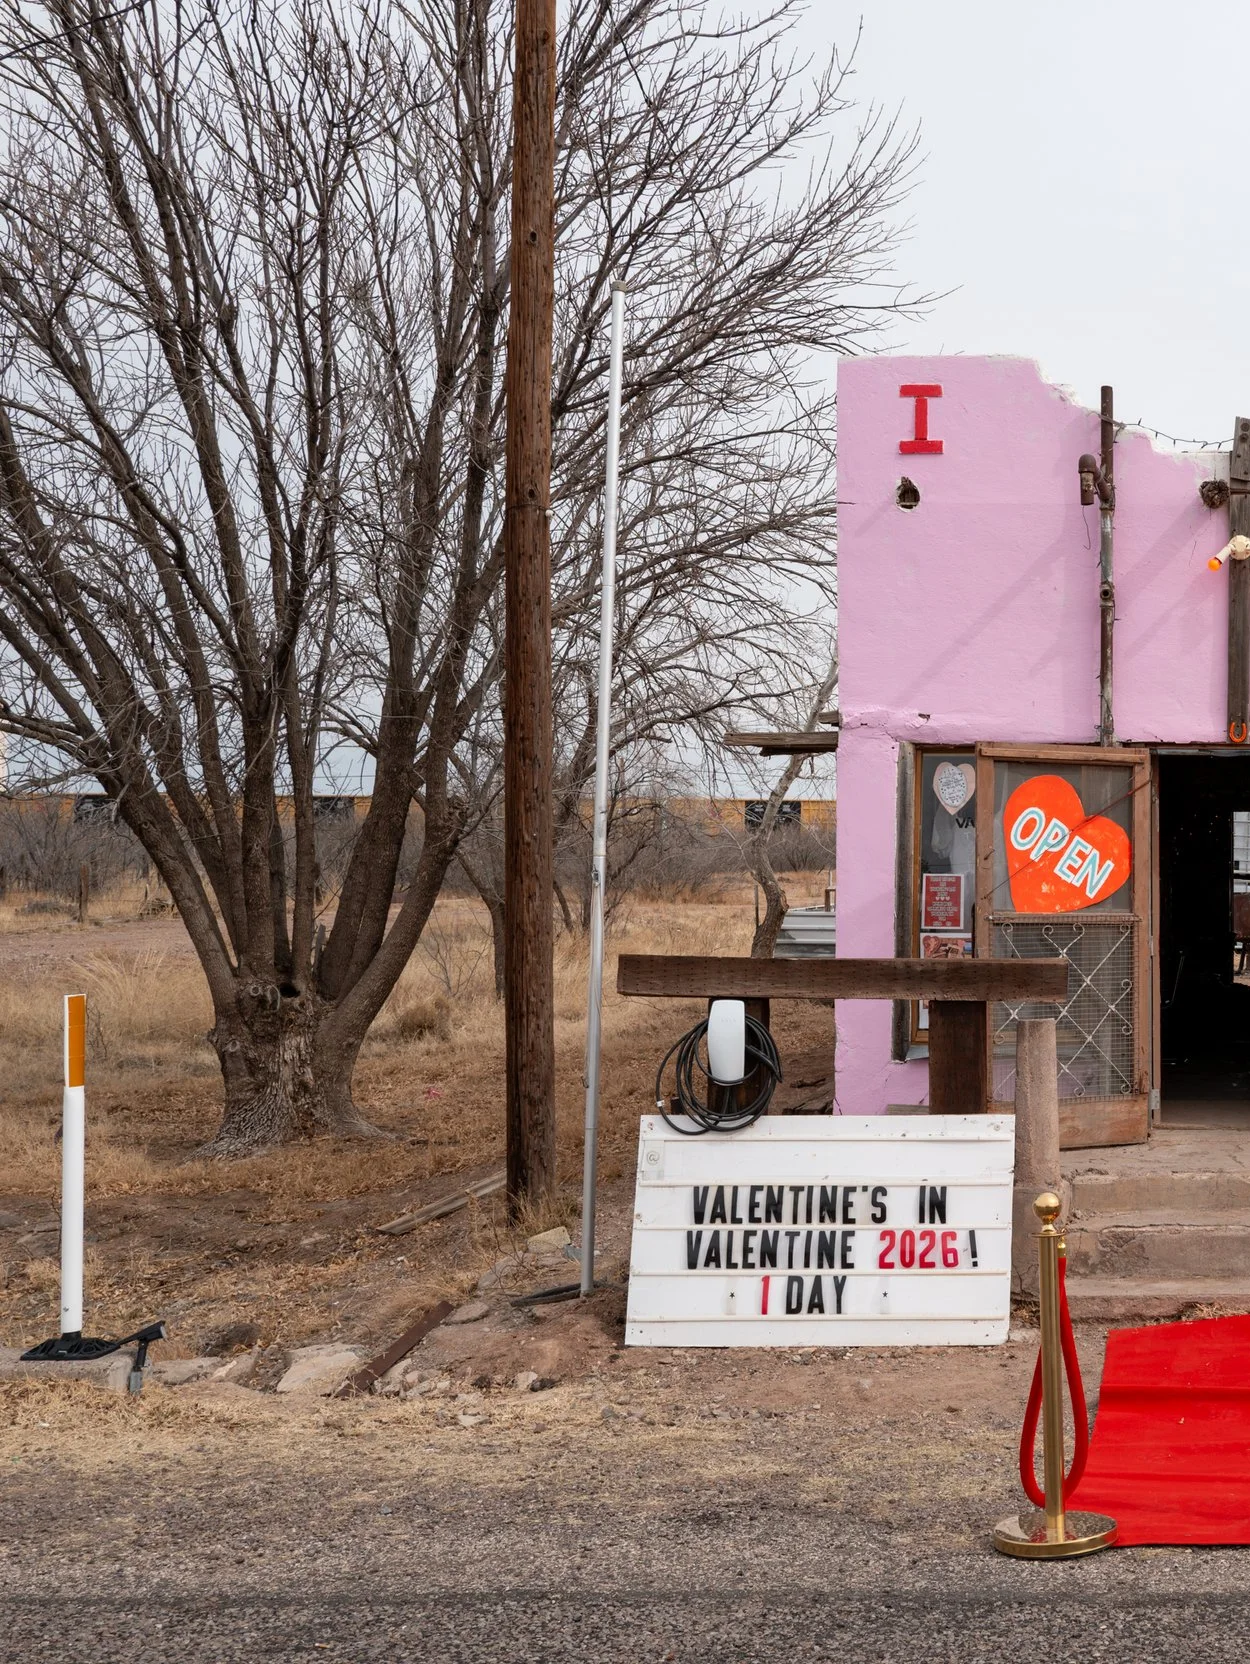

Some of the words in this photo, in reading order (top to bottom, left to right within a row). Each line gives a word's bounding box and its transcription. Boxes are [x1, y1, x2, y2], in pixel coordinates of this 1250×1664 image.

[1010, 806, 1115, 899] OPEN
[692, 1185, 888, 1225] VALENTINE'S
[918, 1185, 948, 1225] IN
[686, 1230, 856, 1270] VALENTINE
[760, 1275, 771, 1315] 1
[785, 1275, 848, 1315] DAY
